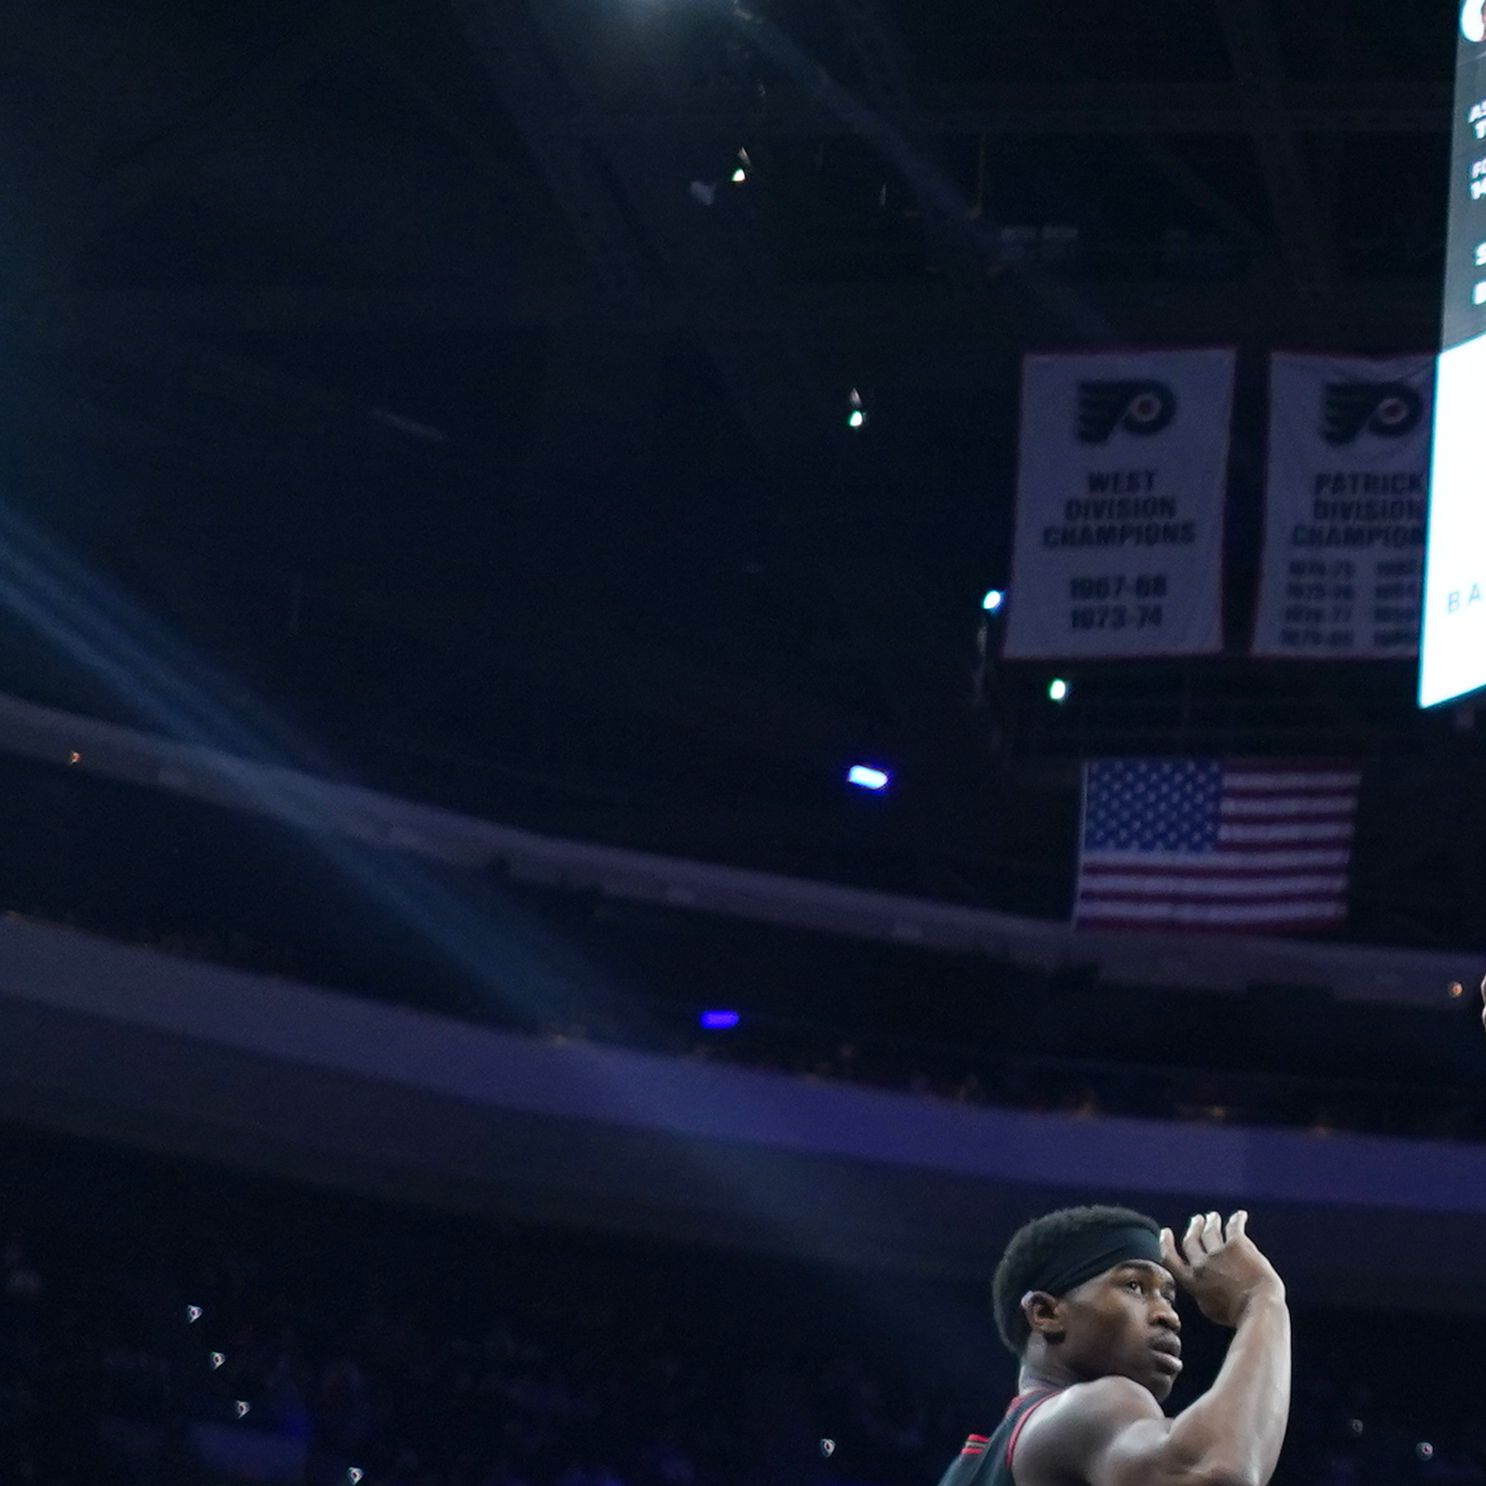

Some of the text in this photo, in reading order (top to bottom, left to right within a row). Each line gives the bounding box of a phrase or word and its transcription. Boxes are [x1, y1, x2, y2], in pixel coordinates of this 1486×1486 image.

[1087, 471, 1158, 493] WEST
[1064, 497, 1177, 521] DIVISION
[1042, 522, 1196, 547] CHAMPIONS
[1292, 525, 1430, 547] CHAMPION
